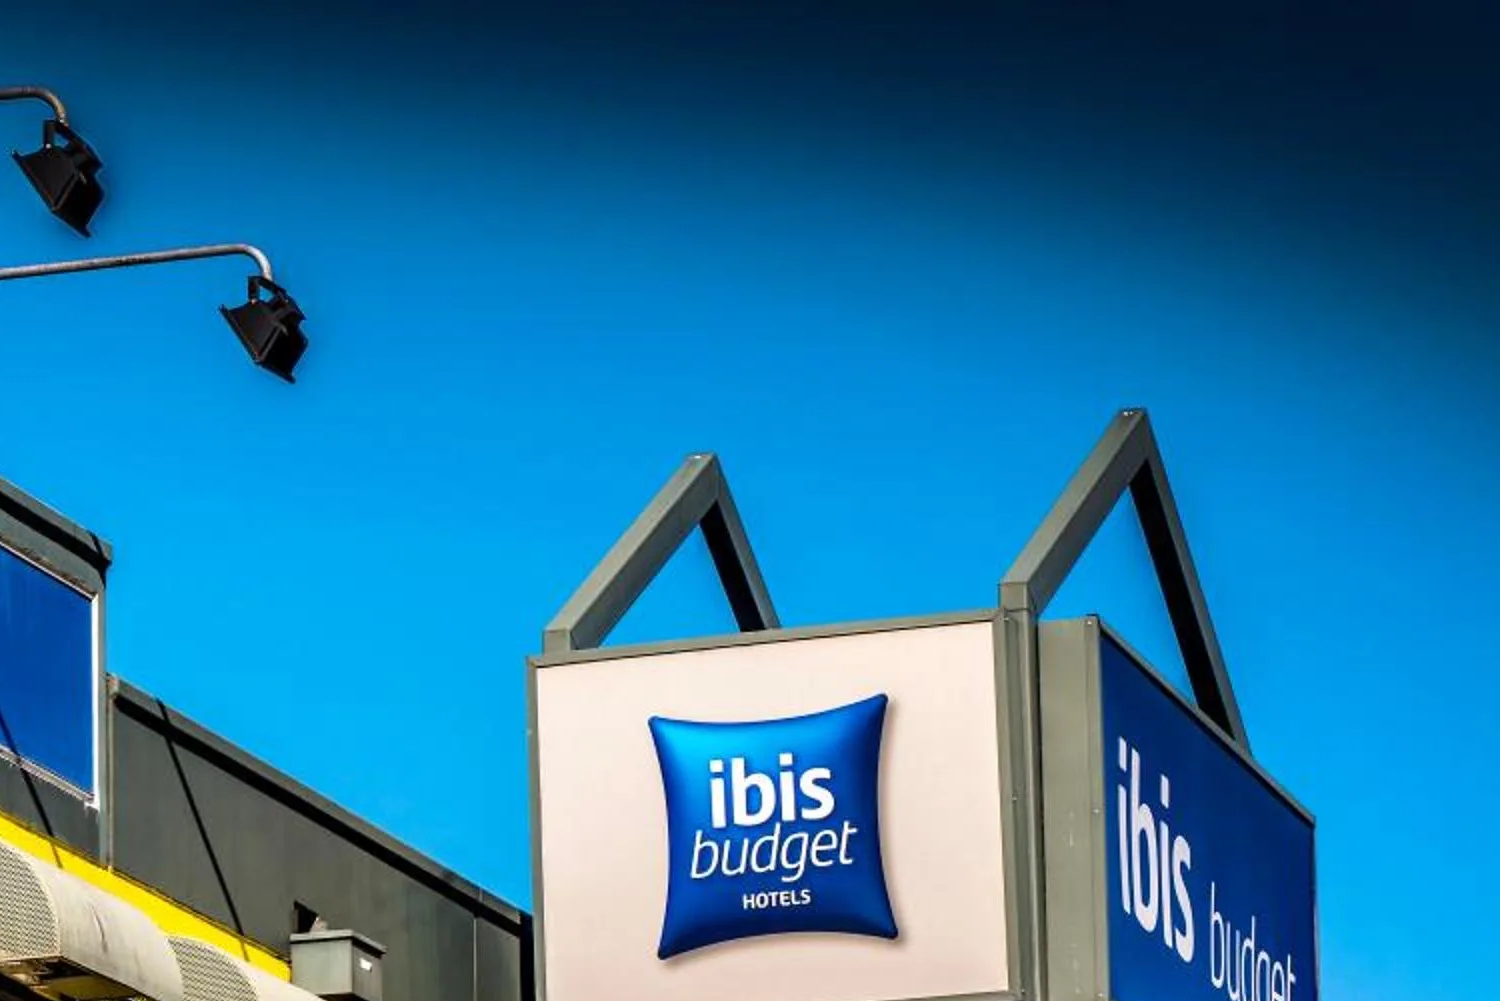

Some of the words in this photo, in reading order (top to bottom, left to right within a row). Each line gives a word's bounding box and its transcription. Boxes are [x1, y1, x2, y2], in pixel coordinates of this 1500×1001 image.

[709, 752, 835, 829] ibis
[690, 820, 858, 882] budget
[1117, 735, 1195, 963] ibis
[743, 889, 811, 910] HOTELS
